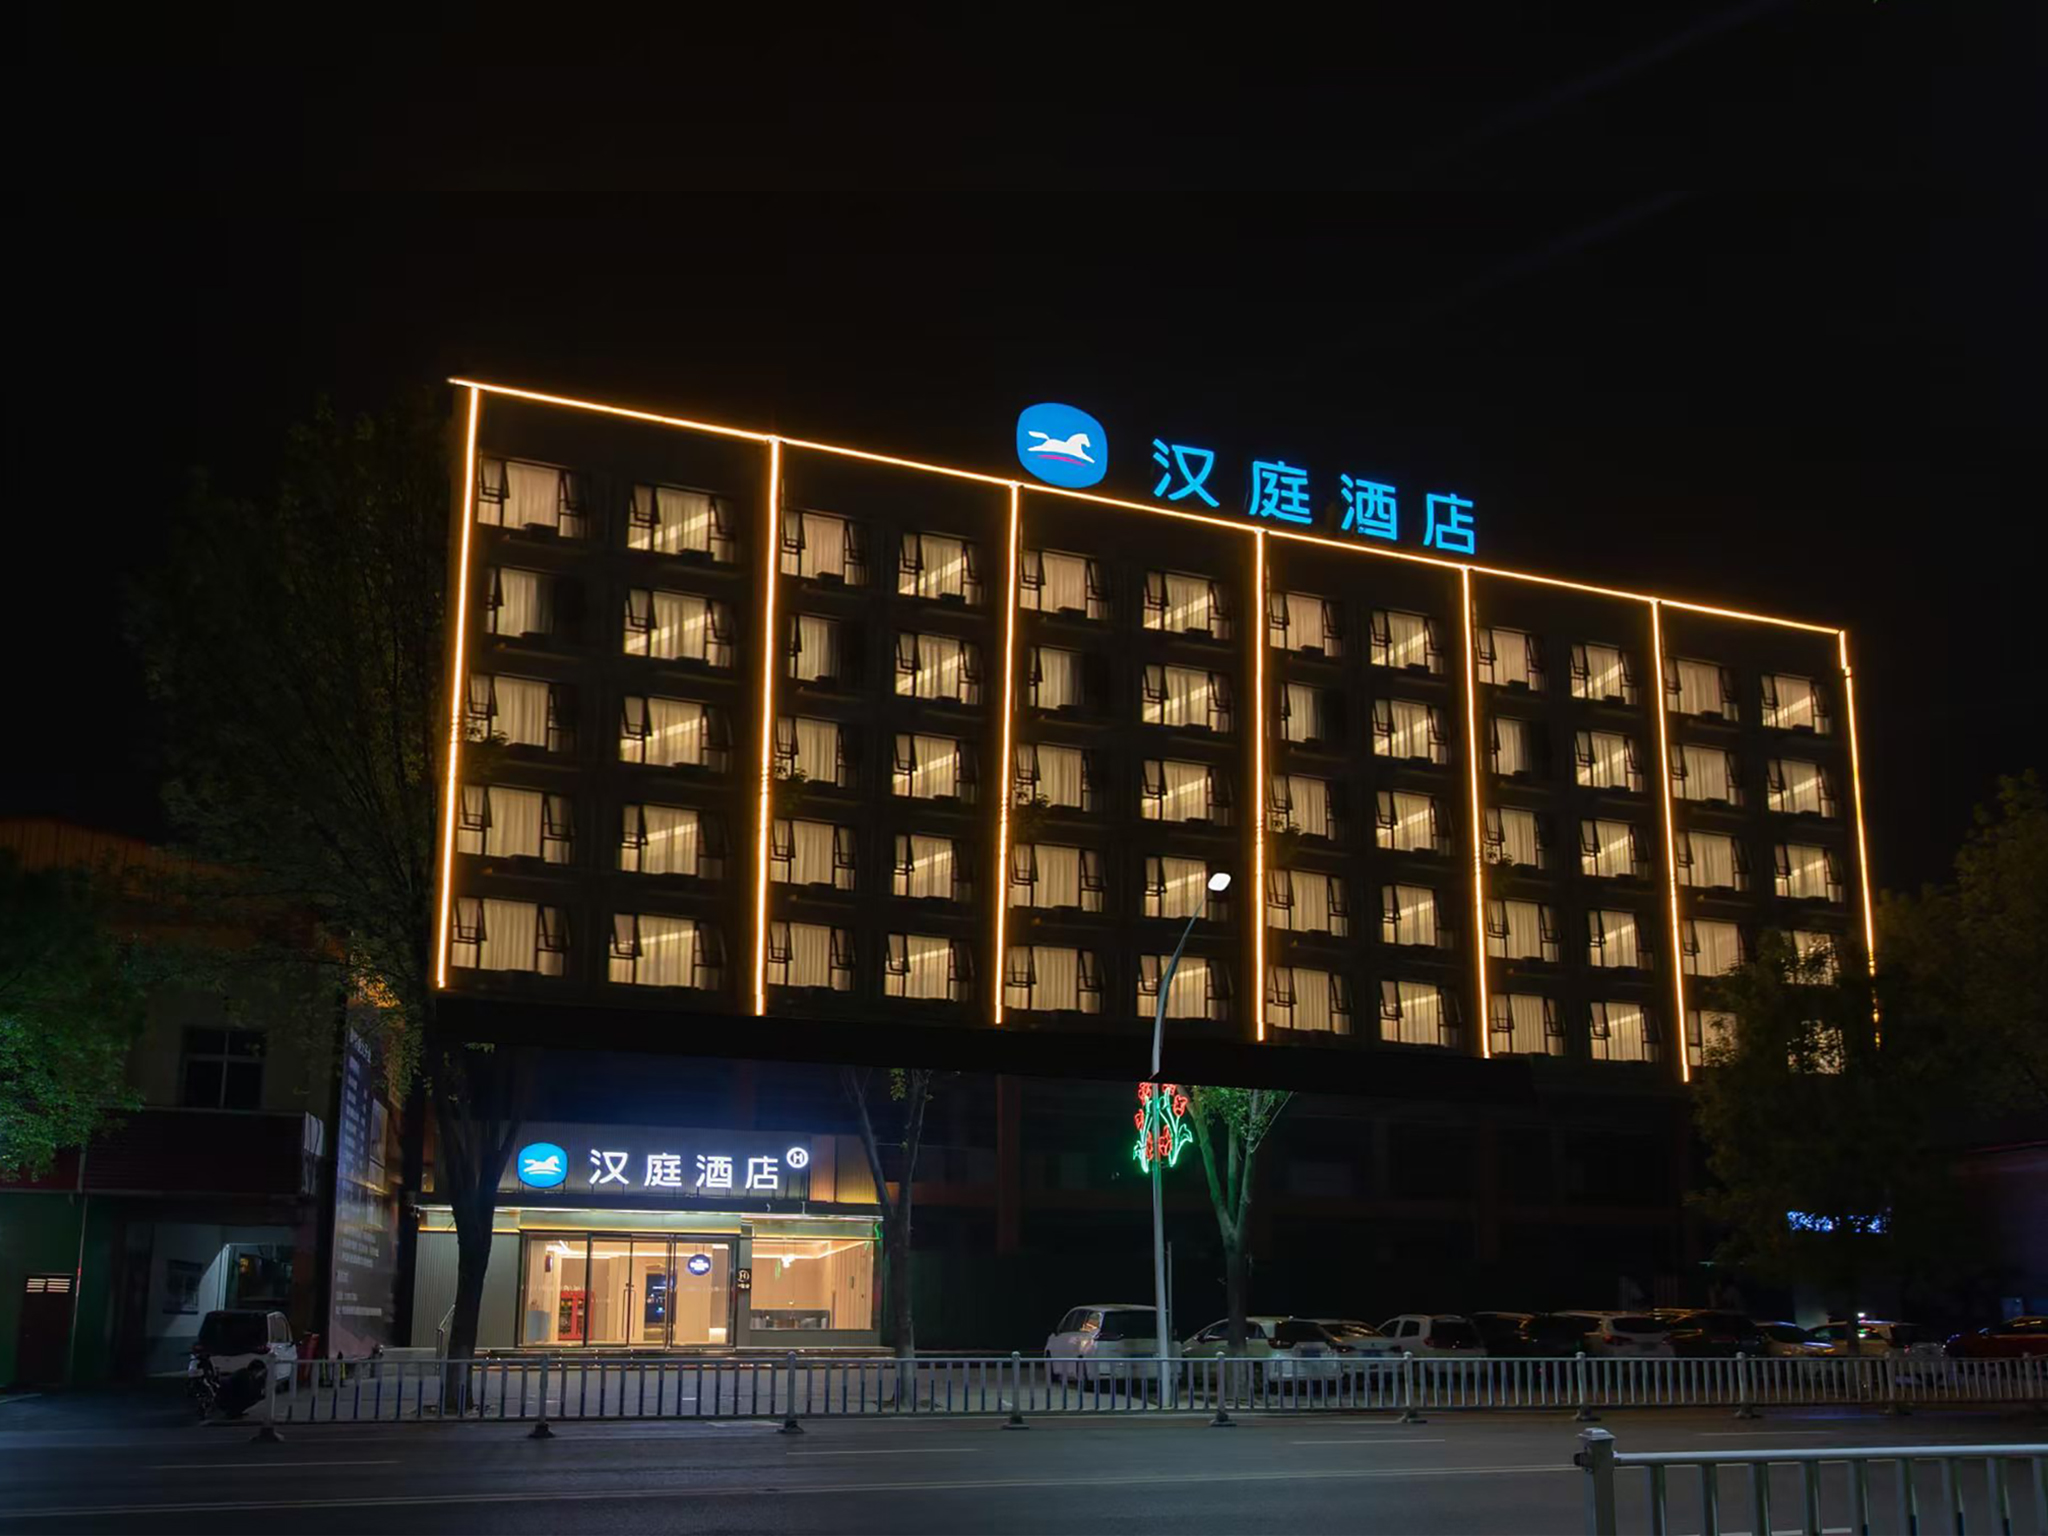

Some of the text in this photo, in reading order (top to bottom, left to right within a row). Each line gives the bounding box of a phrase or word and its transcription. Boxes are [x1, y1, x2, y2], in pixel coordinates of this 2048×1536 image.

[1152, 437, 1476, 555] 汉庭酒店
[588, 1148, 779, 1190] 汉庭酒店
